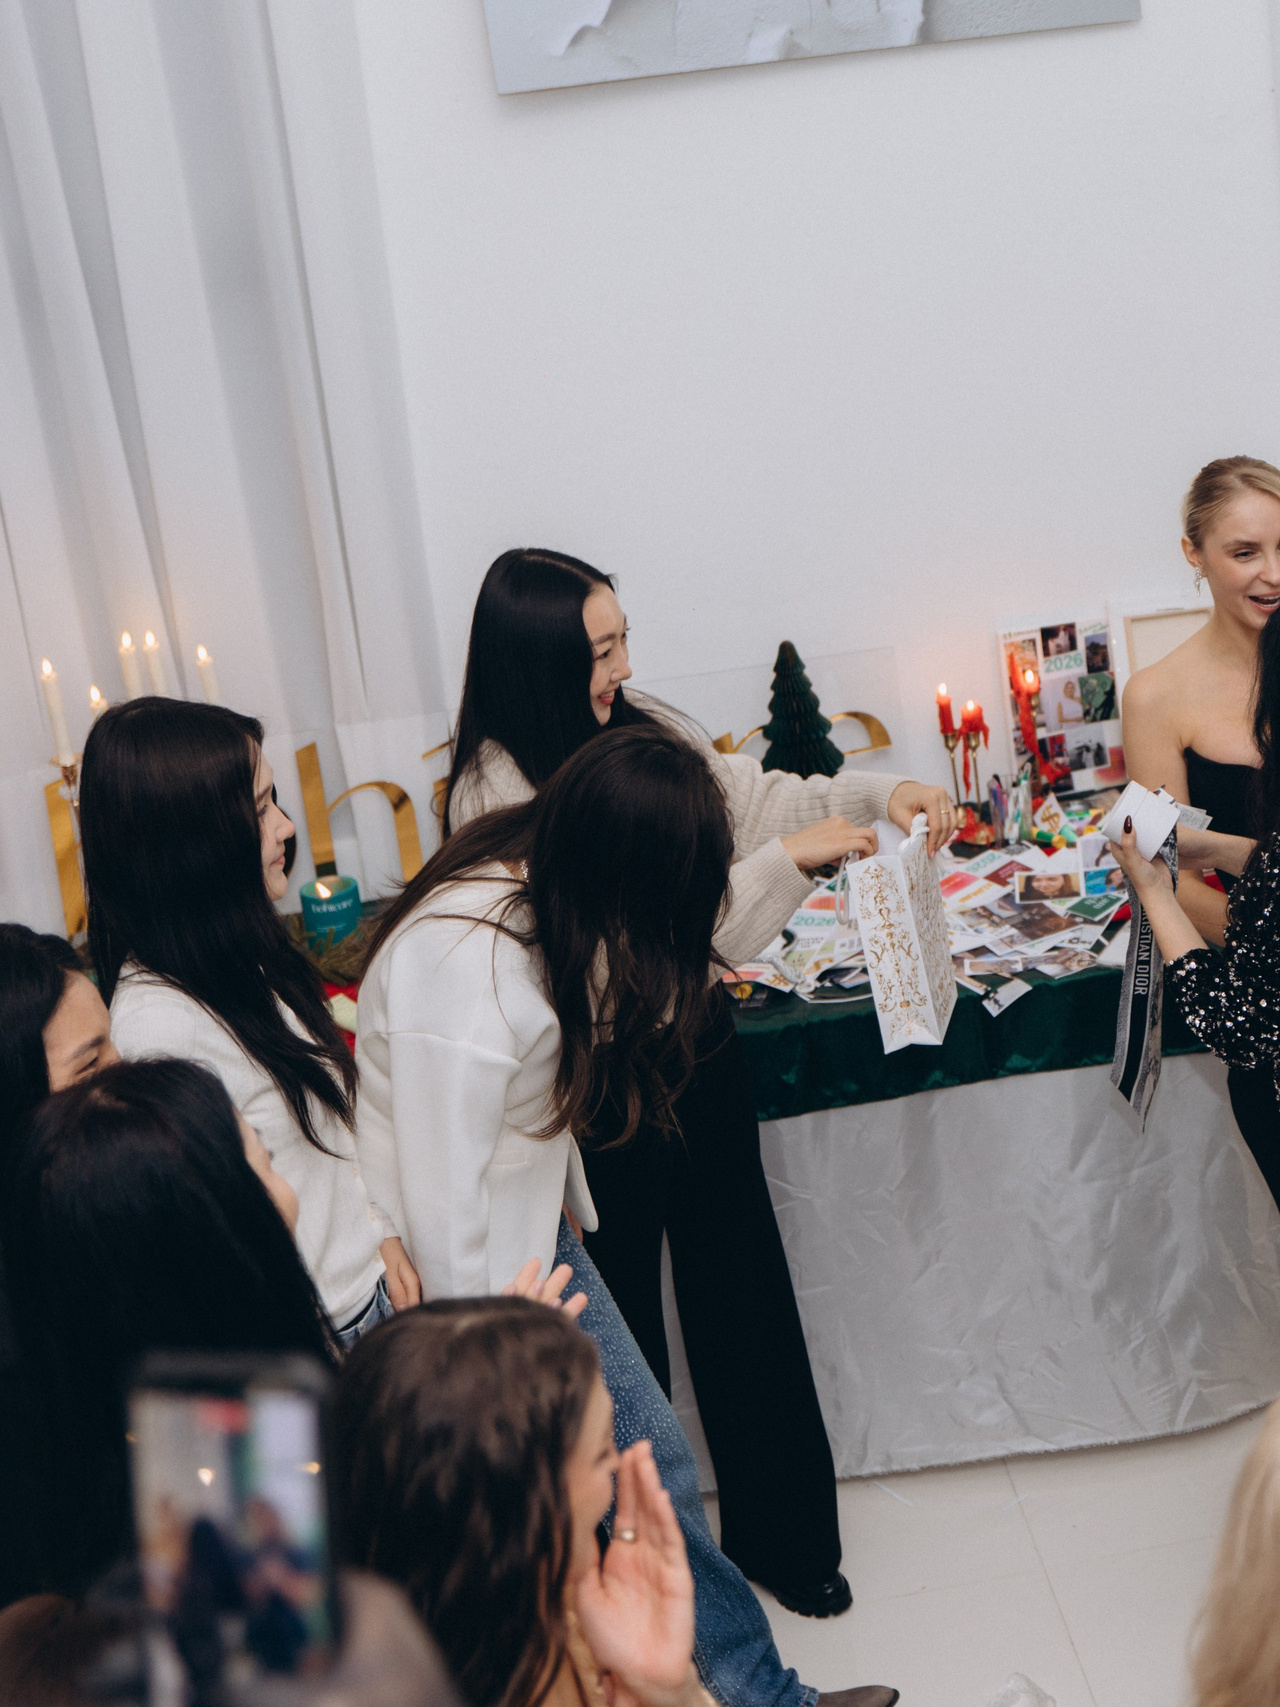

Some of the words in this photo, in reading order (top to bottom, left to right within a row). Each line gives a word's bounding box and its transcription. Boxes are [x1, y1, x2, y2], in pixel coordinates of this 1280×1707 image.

[1044, 652, 1084, 673] 2026
[793, 916, 837, 928] 2026
[1134, 964, 1150, 996] DIOR
